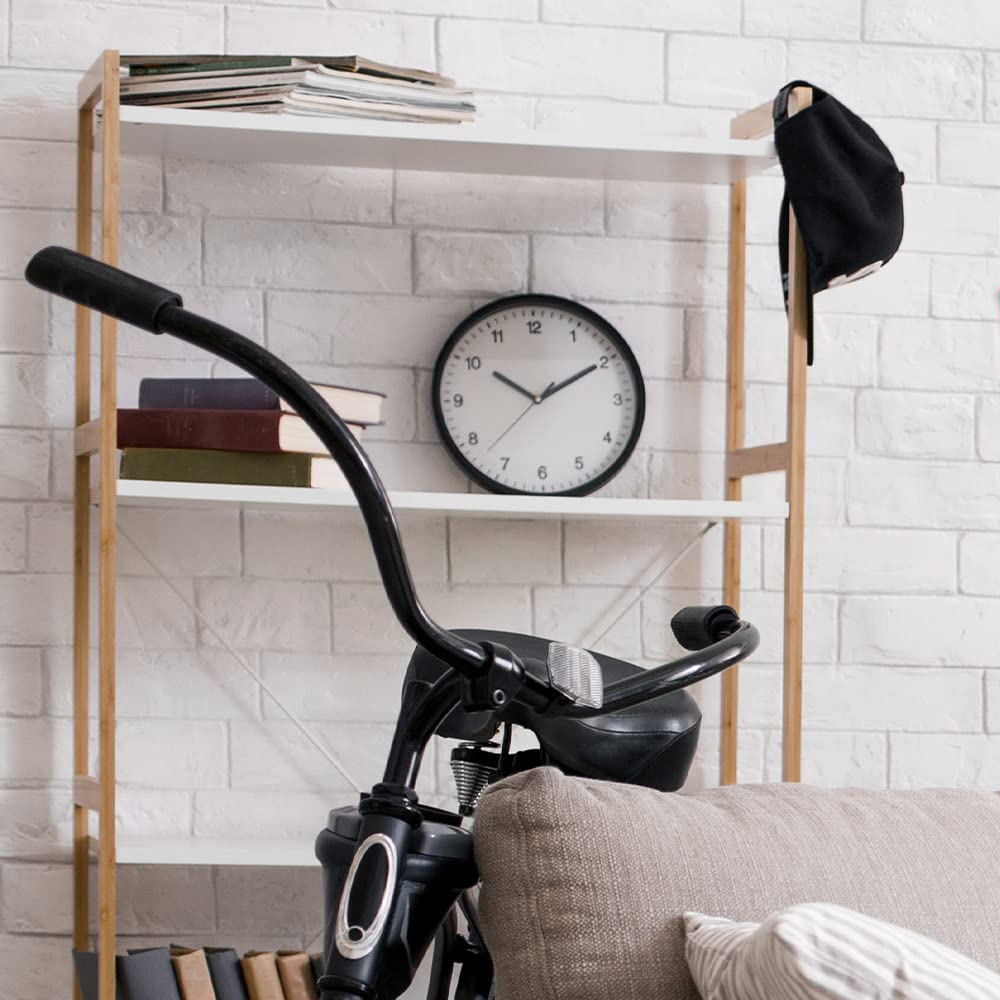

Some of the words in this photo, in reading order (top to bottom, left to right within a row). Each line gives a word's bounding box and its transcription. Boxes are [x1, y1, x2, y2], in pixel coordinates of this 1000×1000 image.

[527, 320, 541, 334] 12
[491, 330, 504, 343] 11
[569, 330, 576, 342] 1
[465, 356, 481, 369] 10
[599, 355, 609, 369] 2
[453, 394, 464, 407] 9
[612, 393, 623, 406] 3
[468, 432, 478, 445] 8
[602, 431, 612, 444] 4
[499, 457, 510, 470] 7
[574, 456, 584, 470] 5
[537, 466, 547, 479] 6
